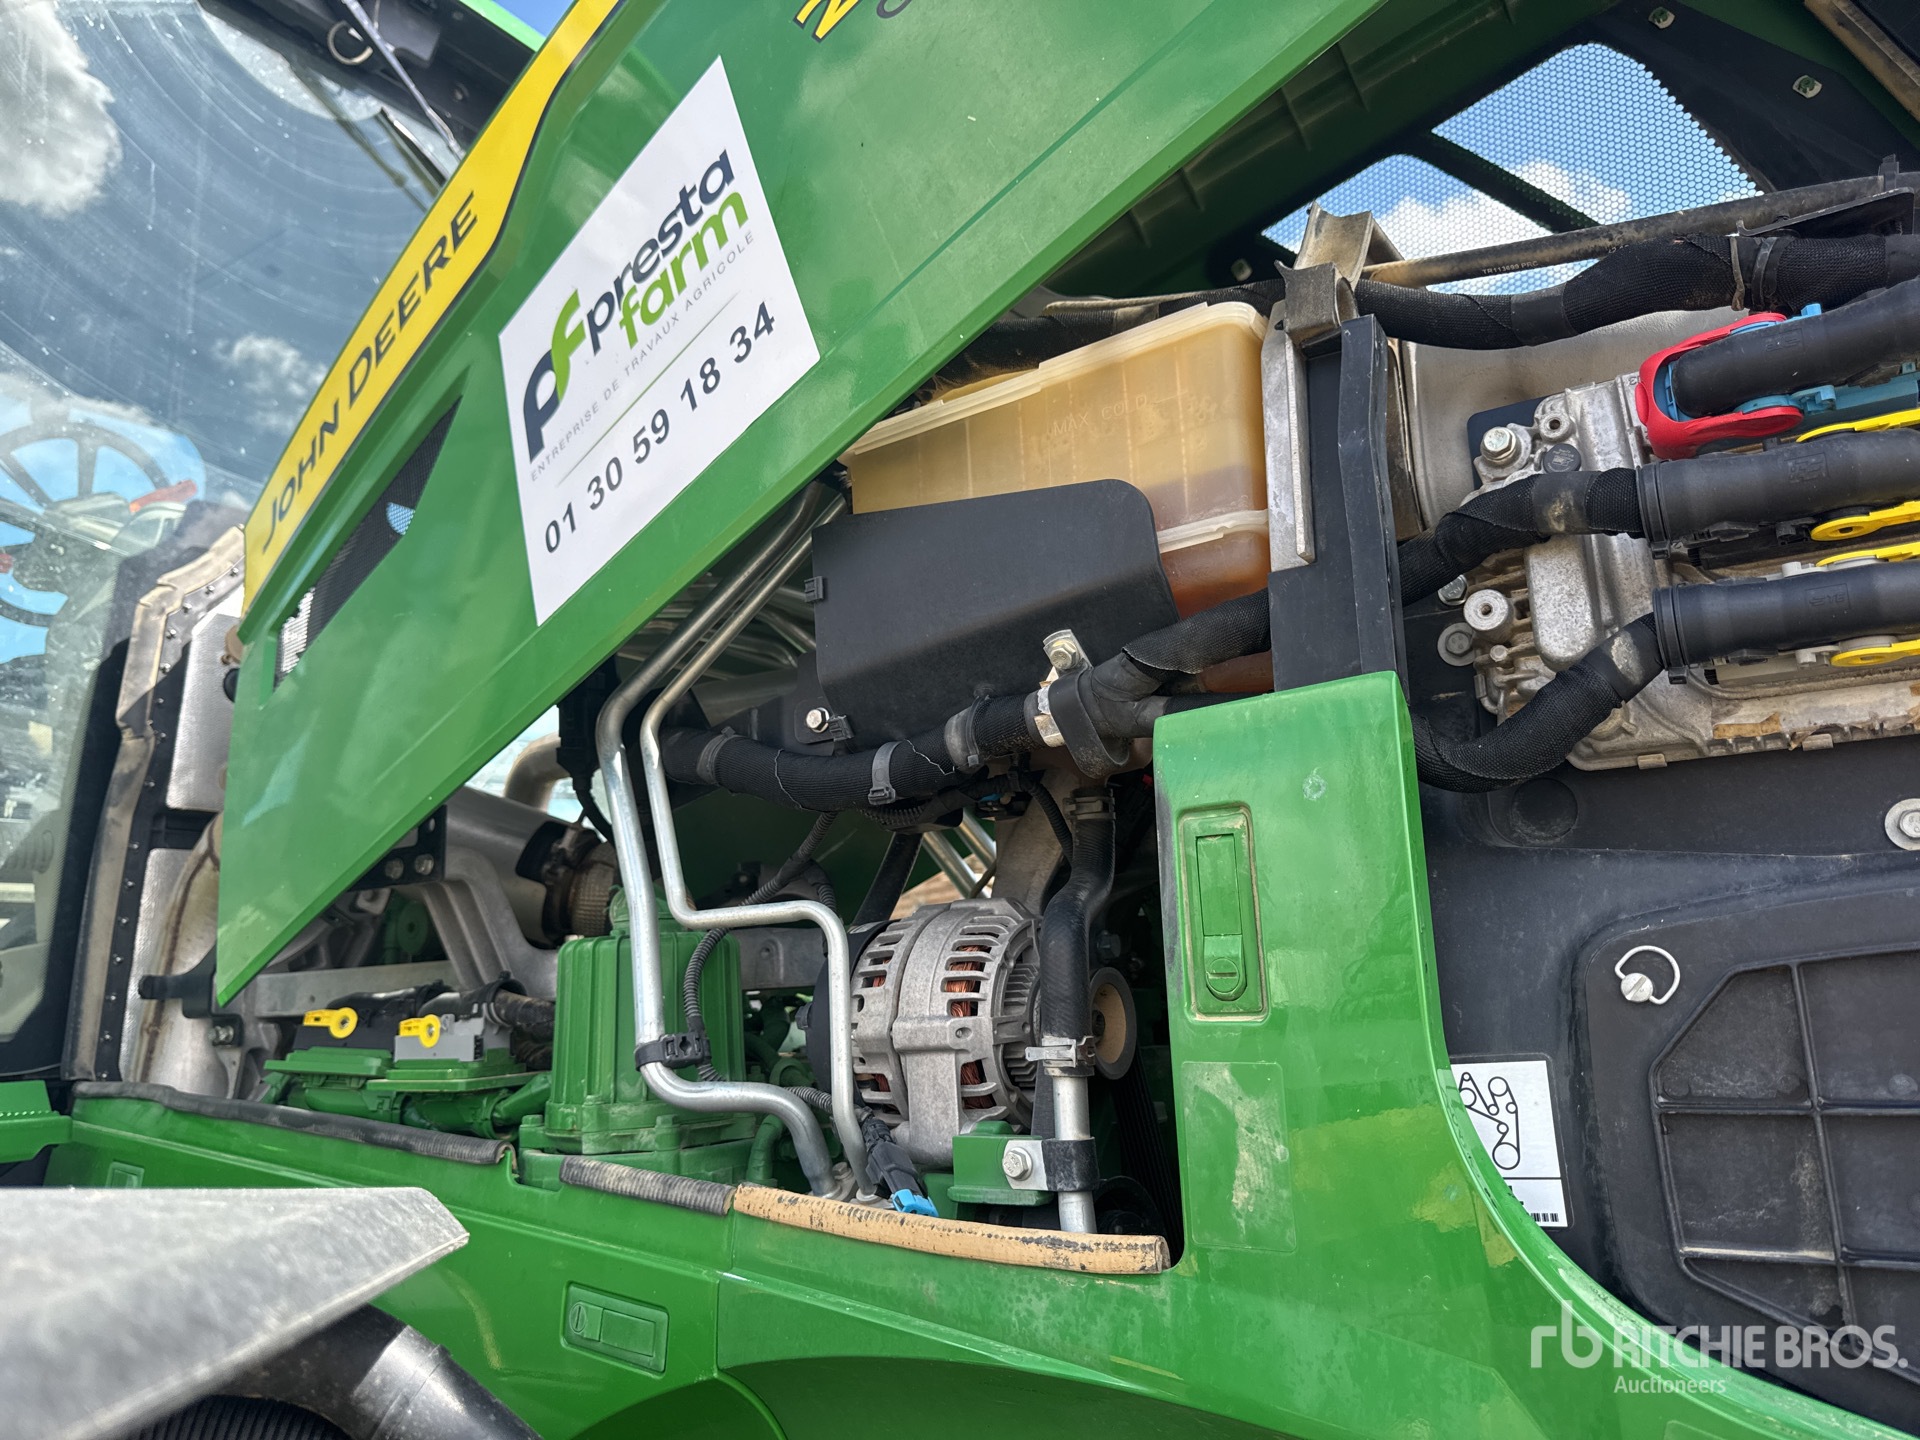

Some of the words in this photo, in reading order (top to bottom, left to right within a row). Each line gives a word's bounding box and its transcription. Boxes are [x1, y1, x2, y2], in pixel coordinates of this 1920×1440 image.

[531, 401, 600, 483] ENTREPRISE
[604, 377, 620, 401] DE
[624, 311, 679, 377] TRAVAUX
[685, 230, 755, 312] AGRICOLE
[586, 148, 735, 356] presta
[619, 191, 749, 350] farm
[262, 397, 340, 555] JOHN
[348, 190, 477, 411] DEERE
[545, 501, 577, 554] 01
[587, 456, 623, 511] 30
[632, 408, 670, 465] 59
[680, 357, 721, 412] 18
[729, 301, 775, 364] 34
[1053, 411, 1089, 436] MAX
[1101, 393, 1147, 420] COLD
